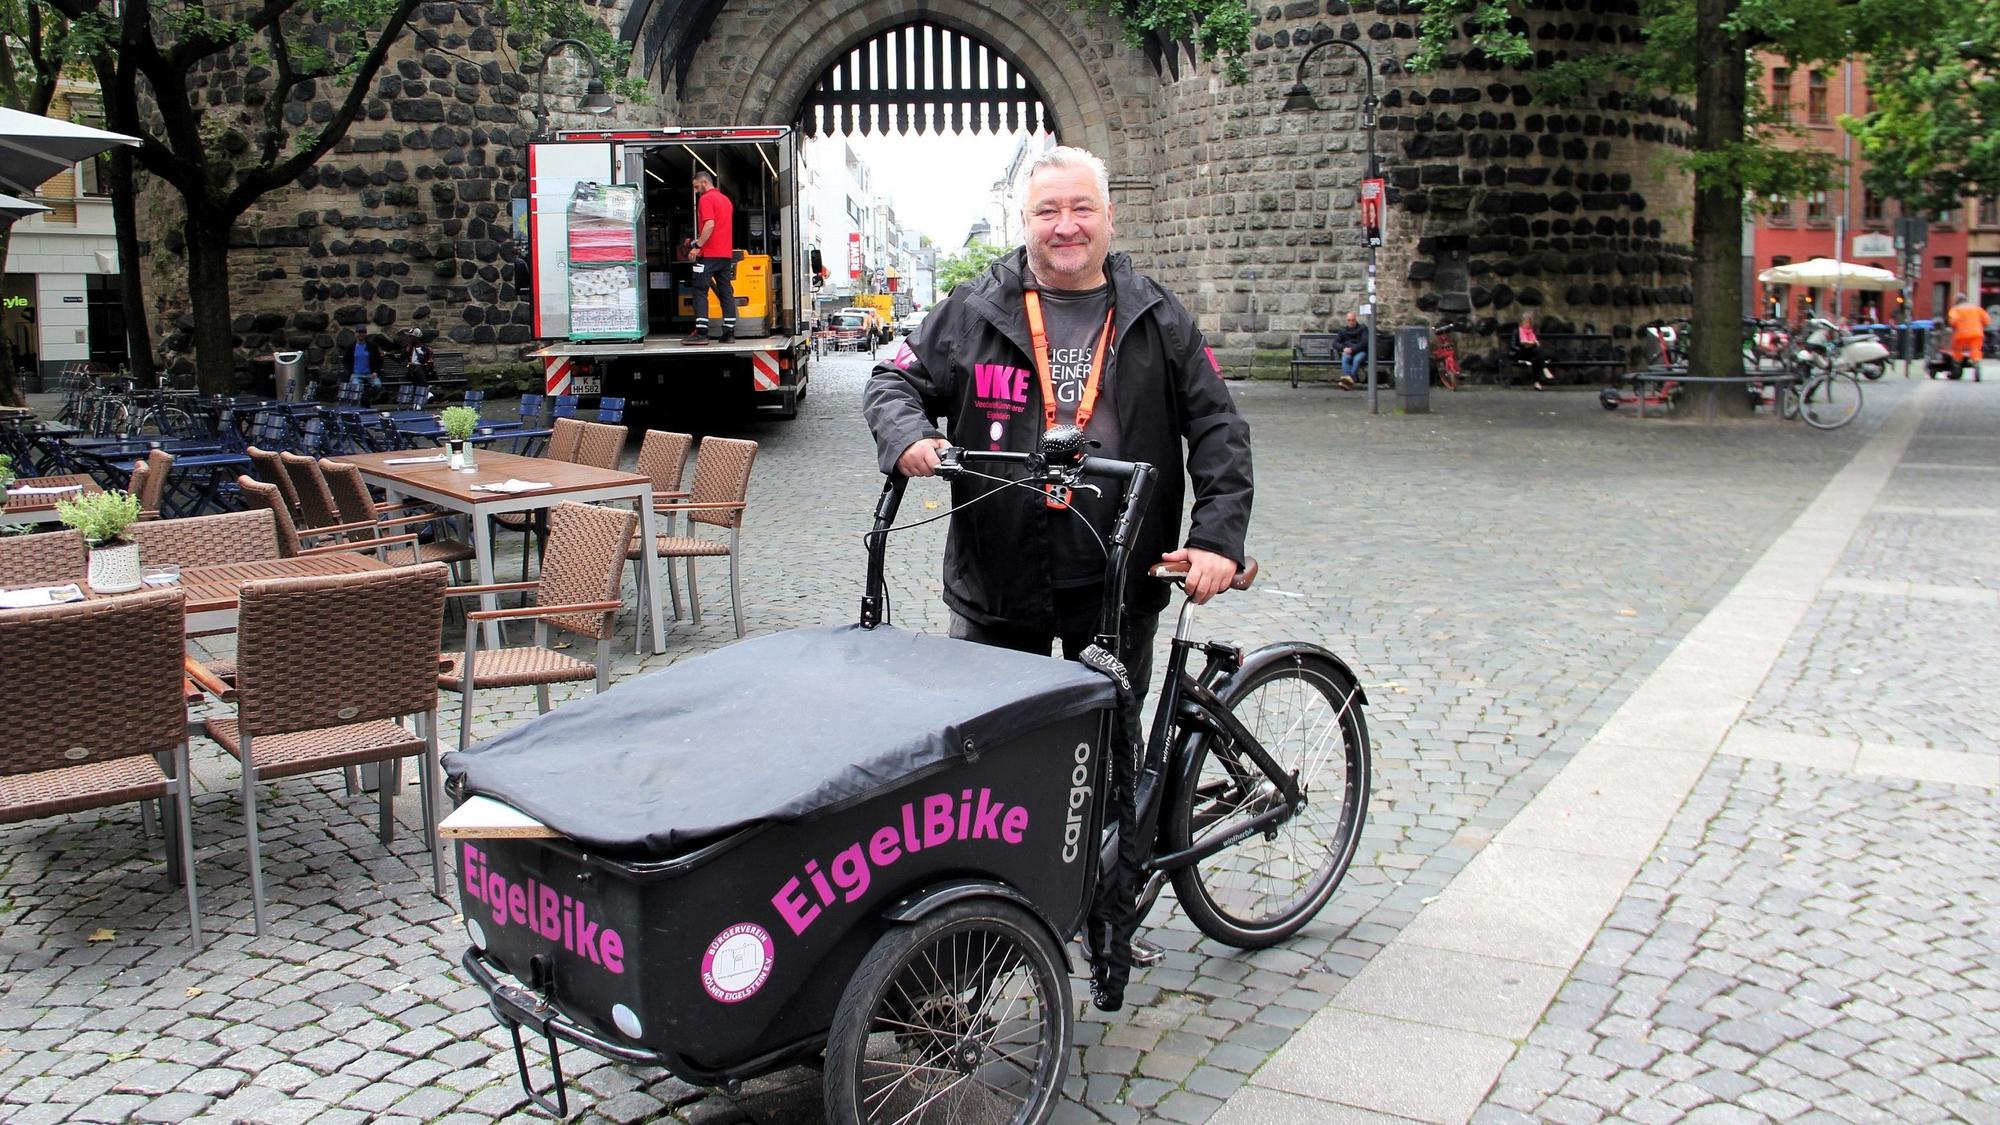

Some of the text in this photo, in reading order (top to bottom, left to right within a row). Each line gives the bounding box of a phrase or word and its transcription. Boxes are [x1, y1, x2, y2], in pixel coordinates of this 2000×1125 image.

[849, 241, 861, 271] REWE
[583, 377, 589, 385] K
[585, 385, 599, 393] 582
[974, 363, 1031, 403] VKE
[1062, 742, 1092, 864] cargoo
[771, 788, 1029, 936] EigelBike
[463, 843, 625, 974] EigelBike
[708, 925, 768, 956] BÜRGERVEREIN
[703, 971, 725, 999] KÖLNER
[724, 972, 768, 1000] EIGELSTEIN
